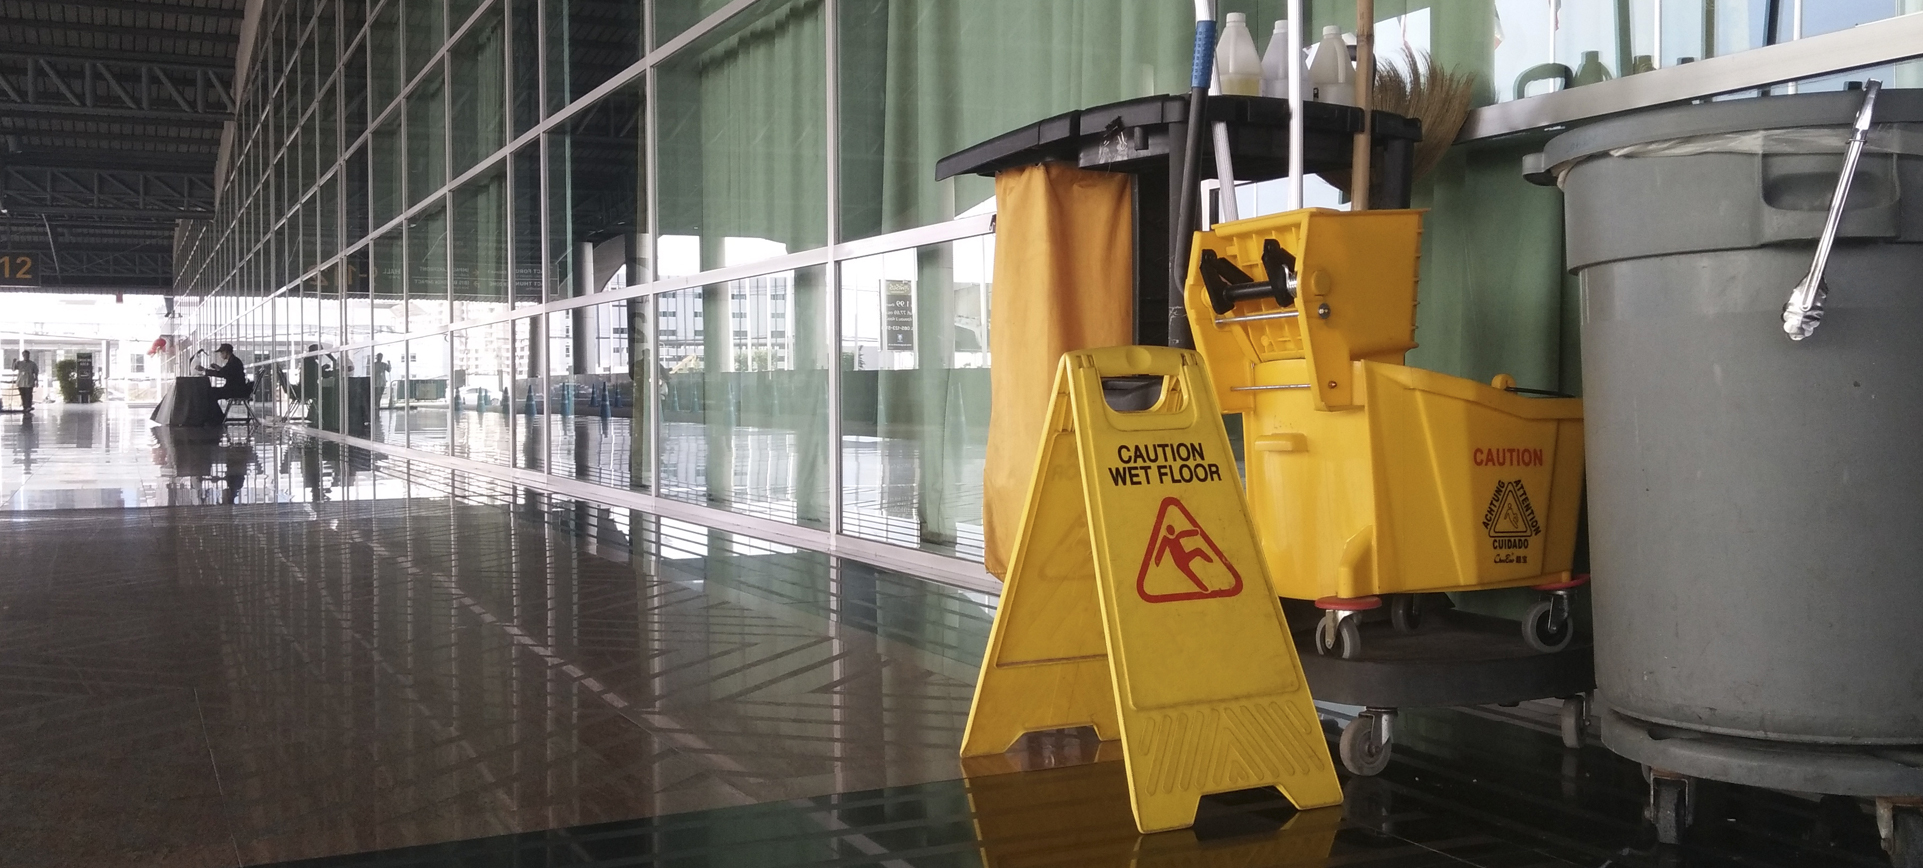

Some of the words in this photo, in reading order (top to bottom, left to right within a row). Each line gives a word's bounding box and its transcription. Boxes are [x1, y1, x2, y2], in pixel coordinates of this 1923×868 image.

[0, 255, 32, 279] 12
[1117, 442, 1205, 464] CAUTION
[1473, 448, 1543, 467] CAUTION
[1108, 465, 1152, 487] WET
[1156, 463, 1222, 484] FLOOR
[1482, 479, 1505, 530] ACHTUNG
[1513, 479, 1541, 536] ATTENTION
[1492, 538, 1529, 550] CUIDADO
